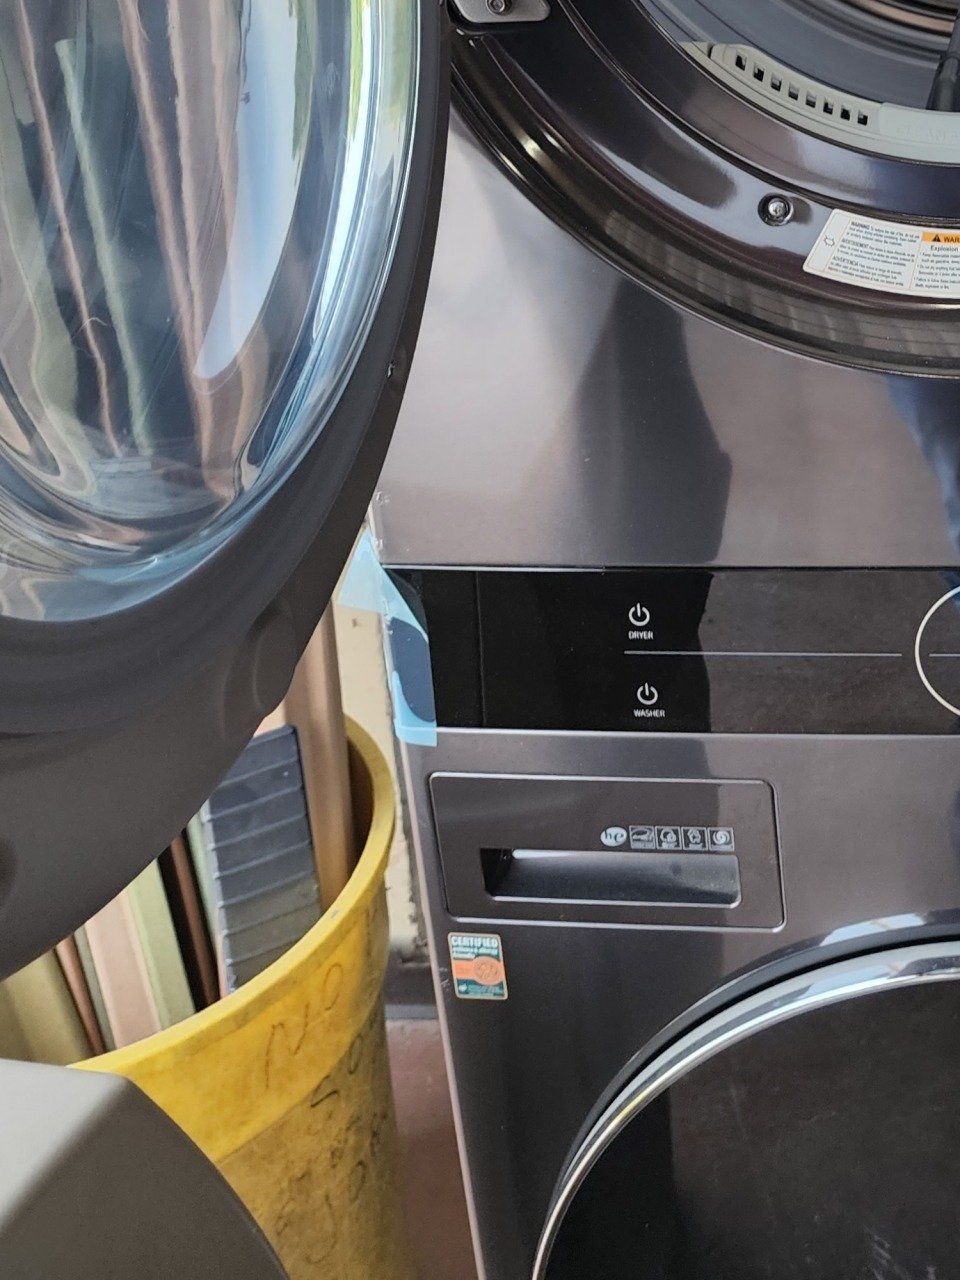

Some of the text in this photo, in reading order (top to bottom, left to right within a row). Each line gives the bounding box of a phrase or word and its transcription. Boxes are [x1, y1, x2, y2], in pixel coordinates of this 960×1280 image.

[628, 630, 654, 640] DRYER
[633, 709, 666, 718] WASHER
[451, 935, 499, 949] CERTIFIED
